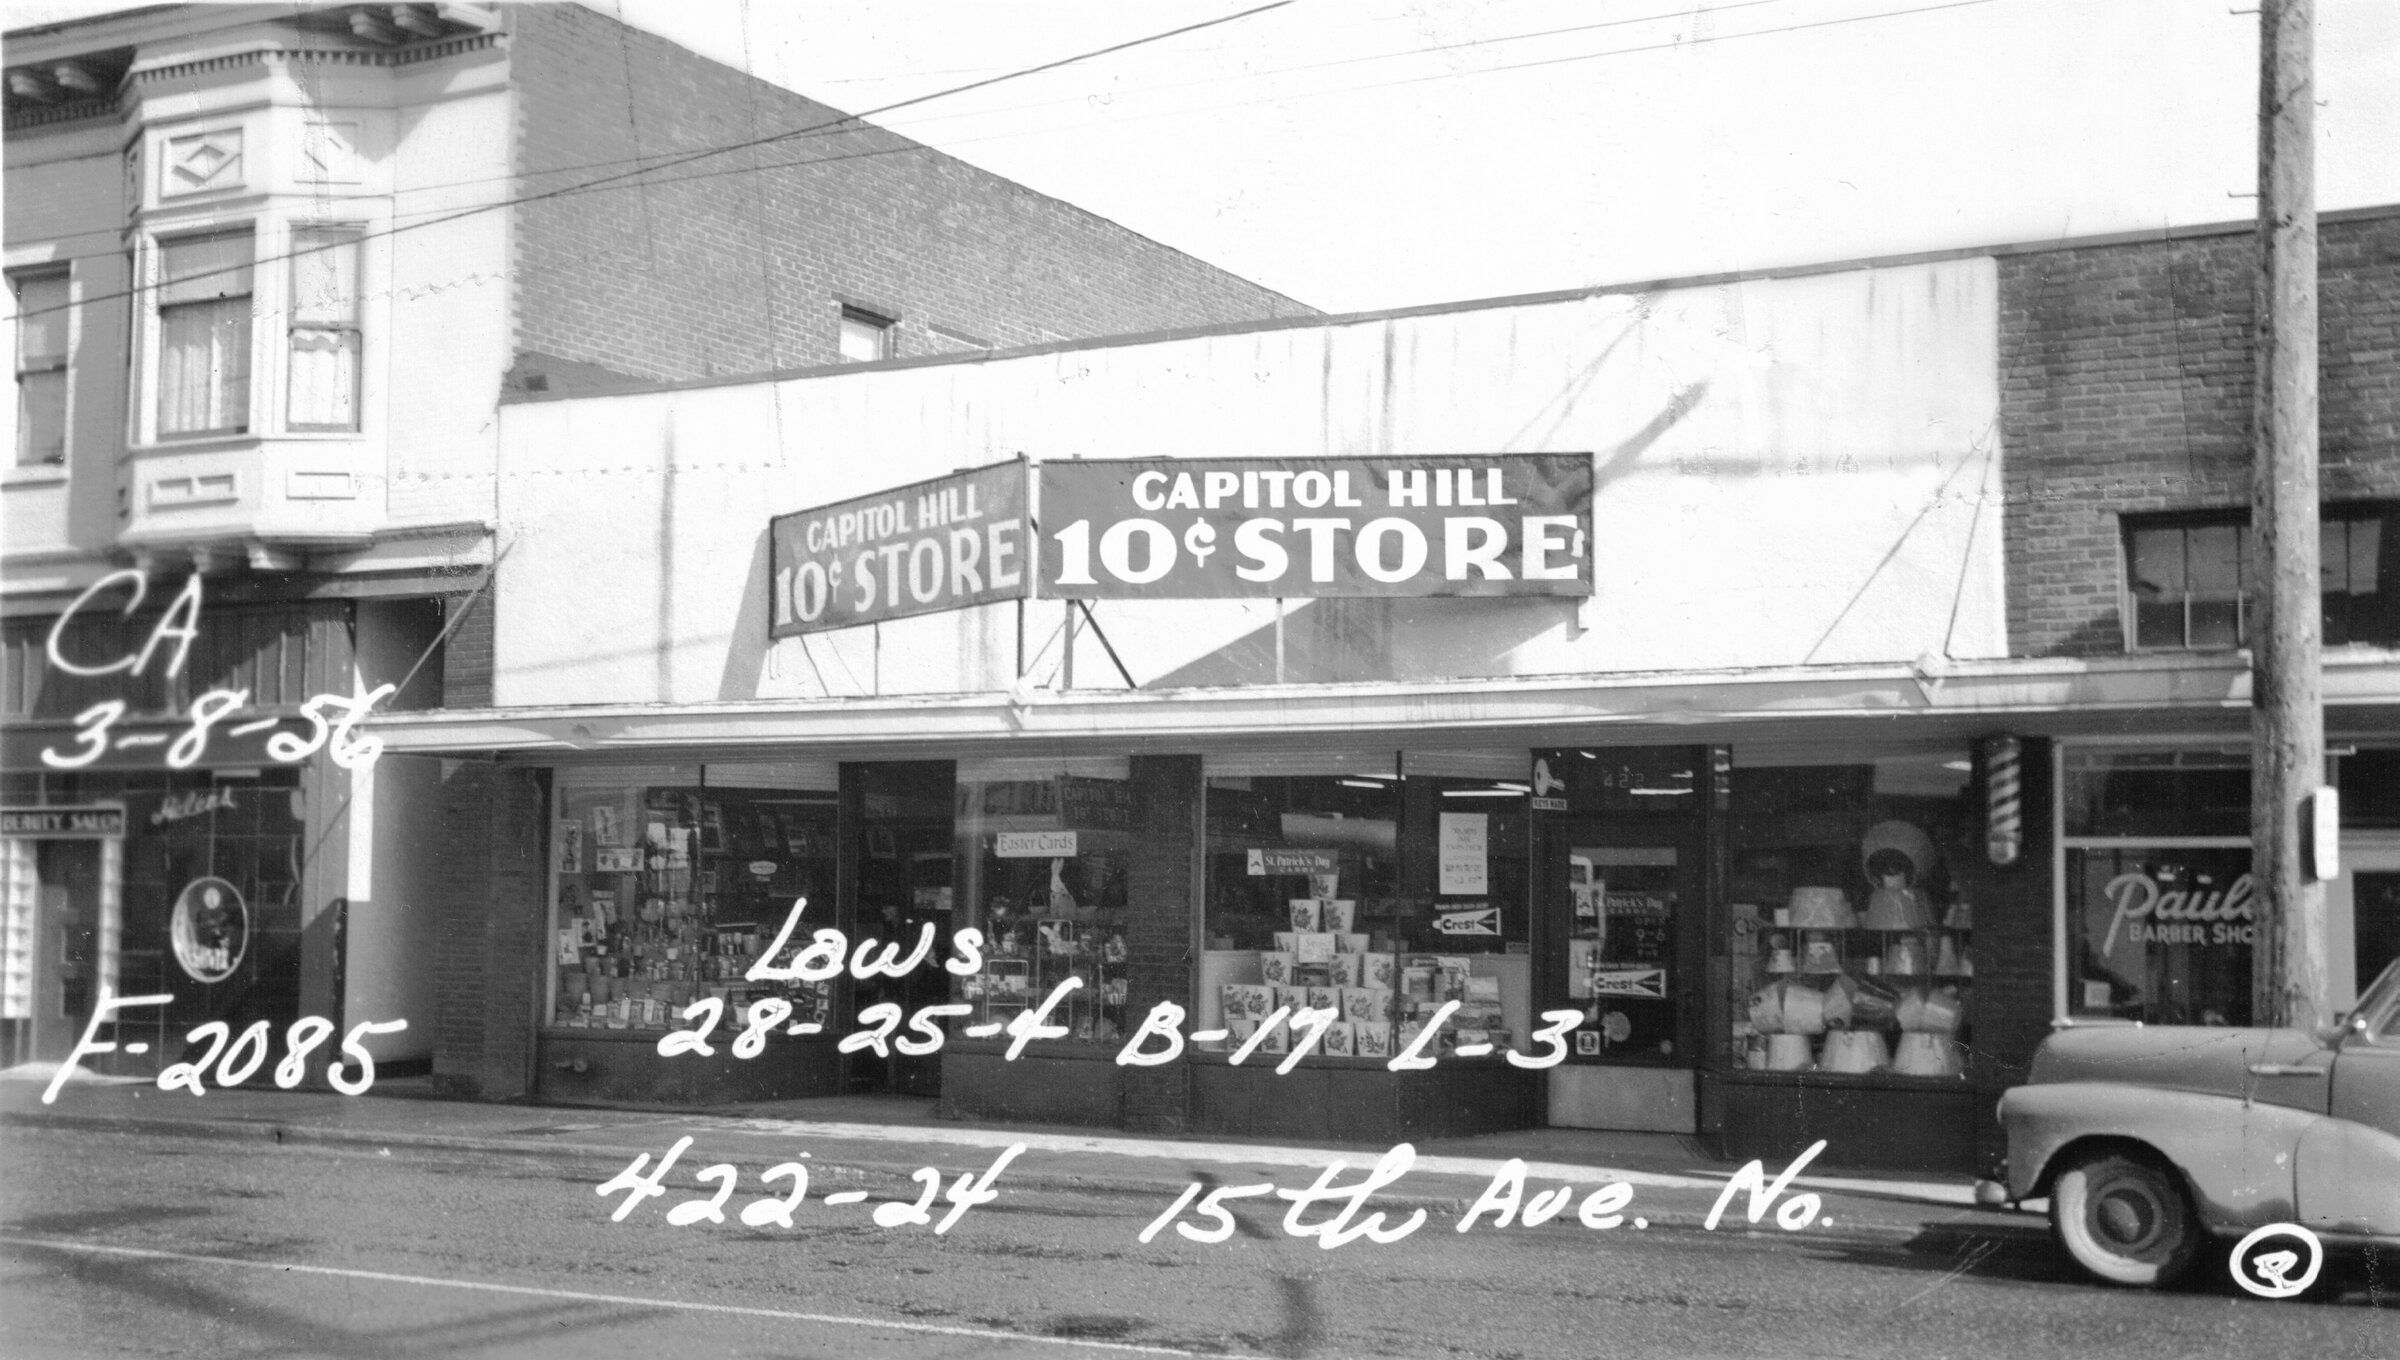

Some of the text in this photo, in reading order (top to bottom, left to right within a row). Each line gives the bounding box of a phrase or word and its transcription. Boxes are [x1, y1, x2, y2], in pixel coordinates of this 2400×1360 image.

[1131, 468, 1518, 511] CAPITOL HILL
[806, 483, 983, 554] CAPITOL HILL
[1603, 773, 1644, 789] 422
[1000, 834, 1073, 852] Easter Cards
[1443, 919, 1475, 931] Crest
[2129, 924, 2207, 946] BARBER
[1595, 978, 1633, 989] Crest
